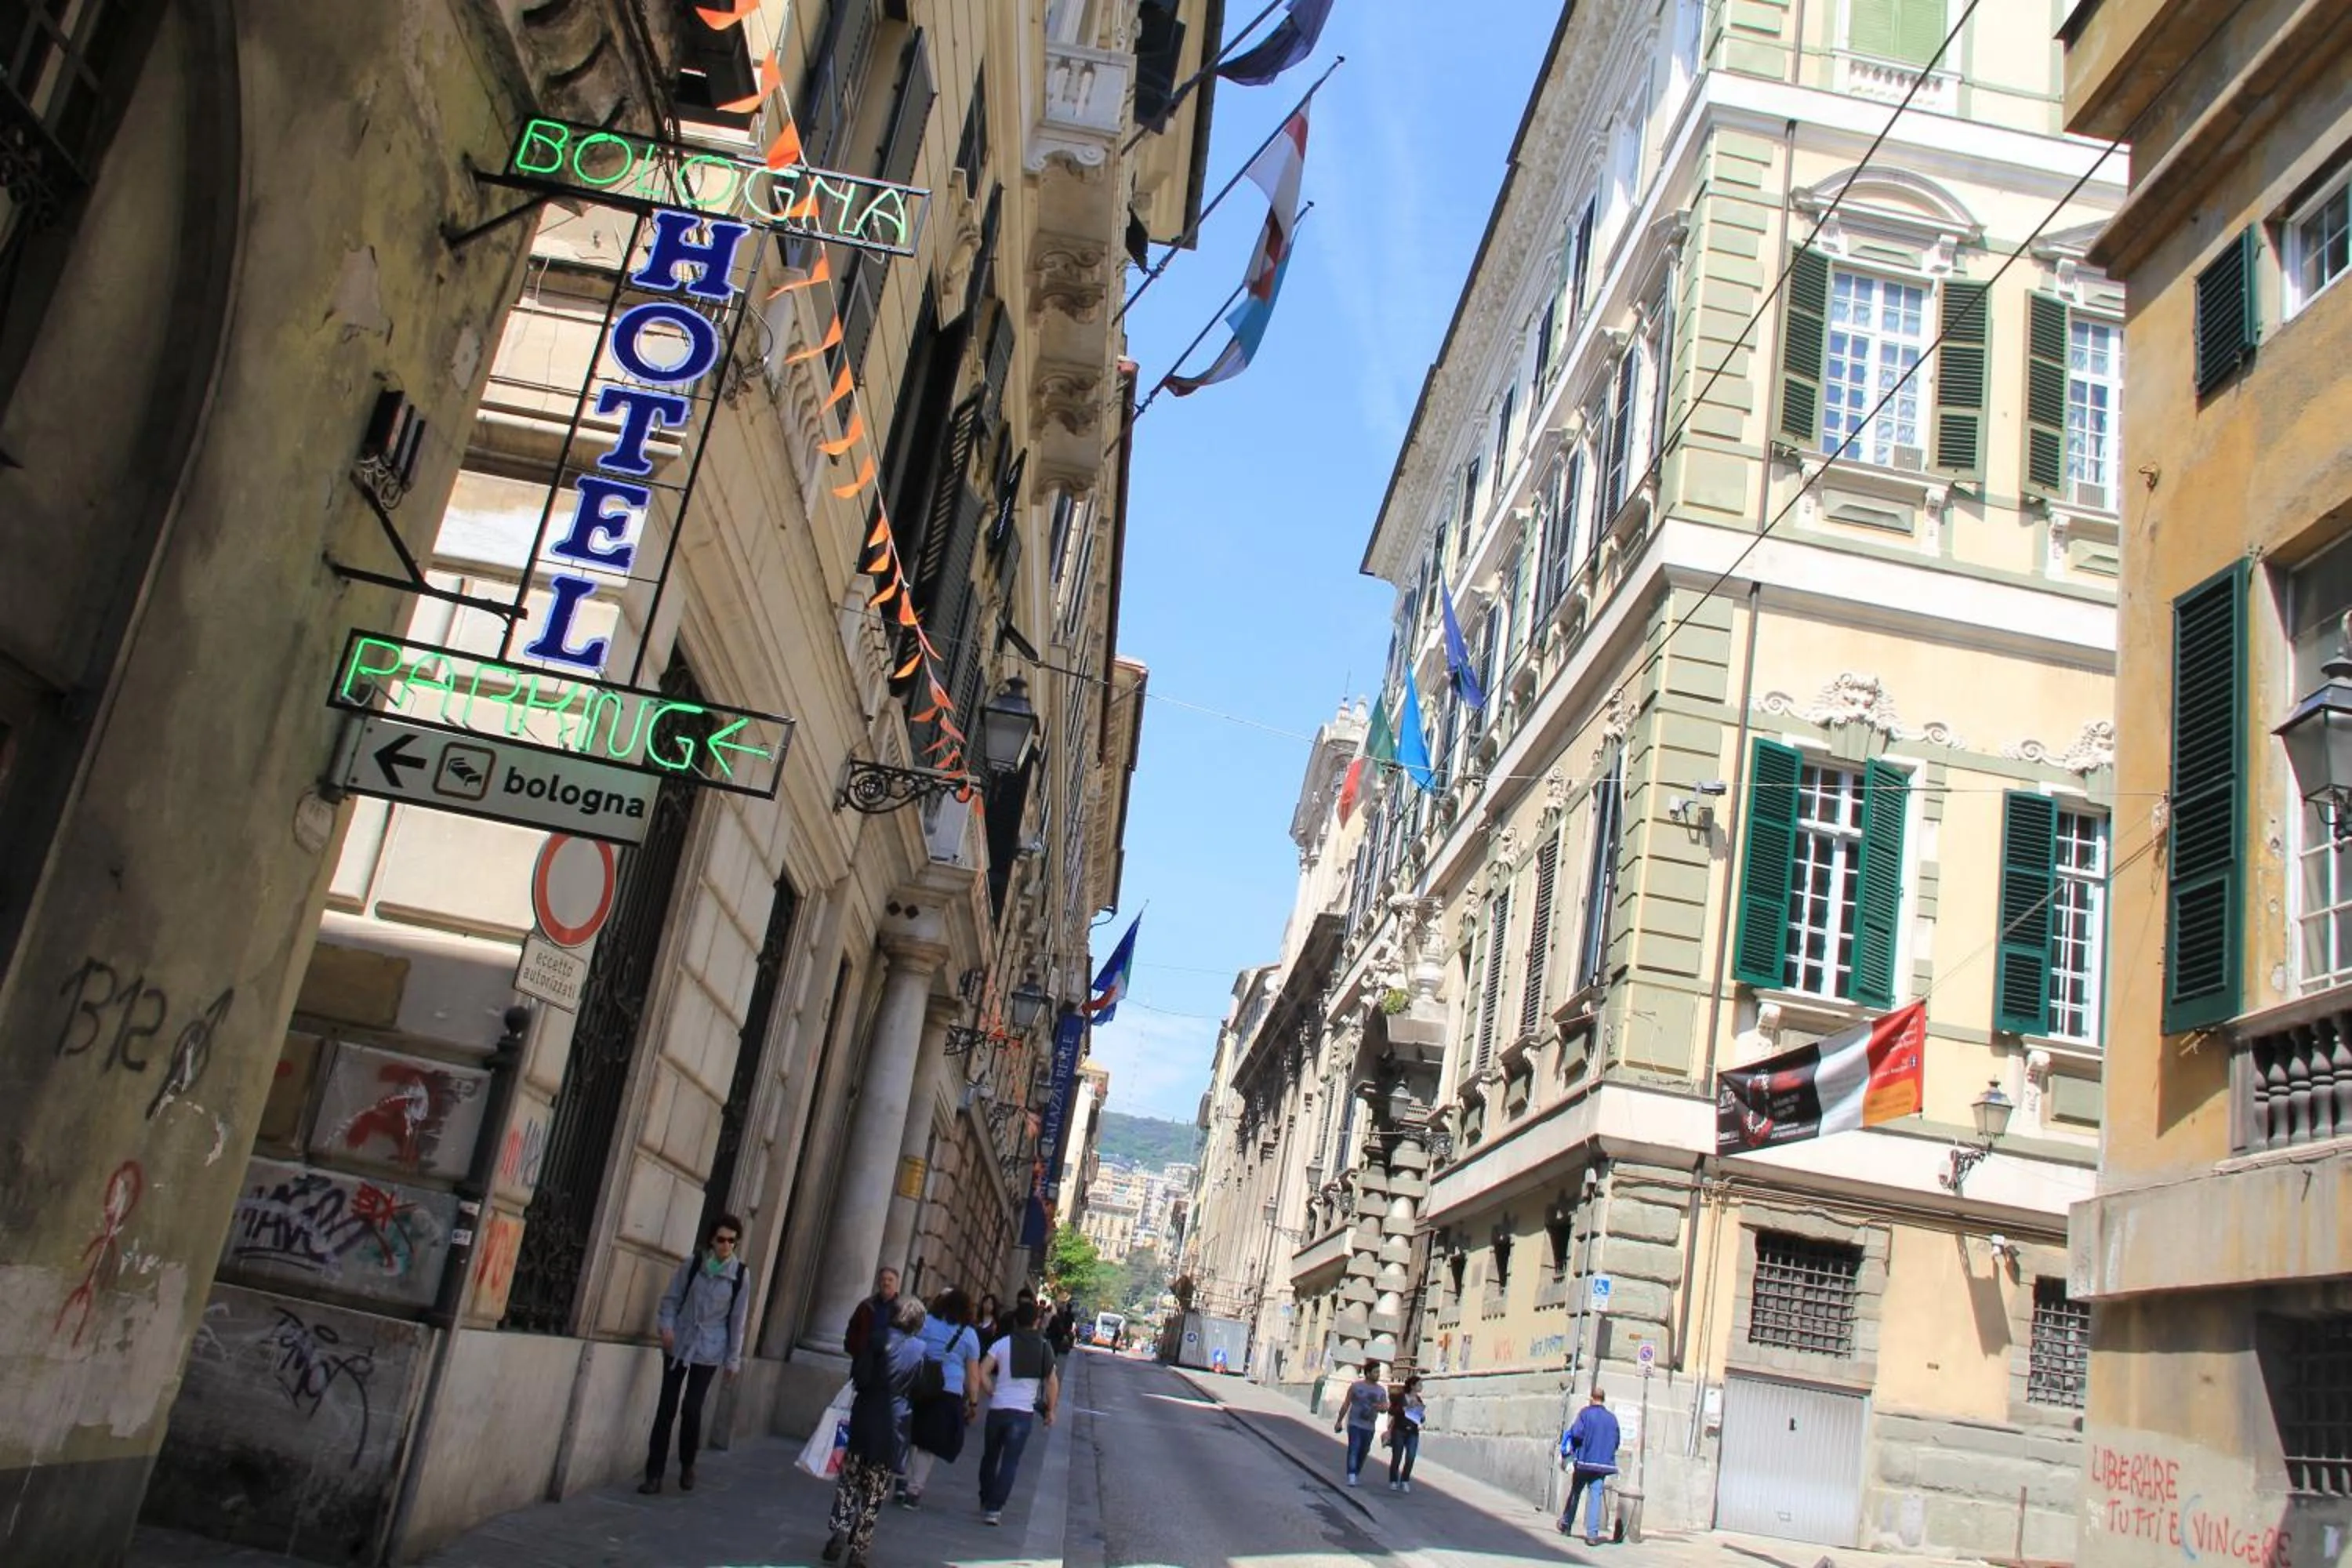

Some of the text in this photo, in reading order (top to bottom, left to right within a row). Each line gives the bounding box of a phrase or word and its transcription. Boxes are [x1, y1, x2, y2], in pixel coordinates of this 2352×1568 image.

[515, 118, 908, 245] BOLOGNA
[524, 208, 750, 669] HOTEL
[339, 637, 704, 771] PARKING
[503, 766, 646, 820] bologna
[523, 966, 576, 1000] autorizzati
[535, 952, 573, 978] eccetto
[2092, 1444, 2180, 1504] LIBERARE
